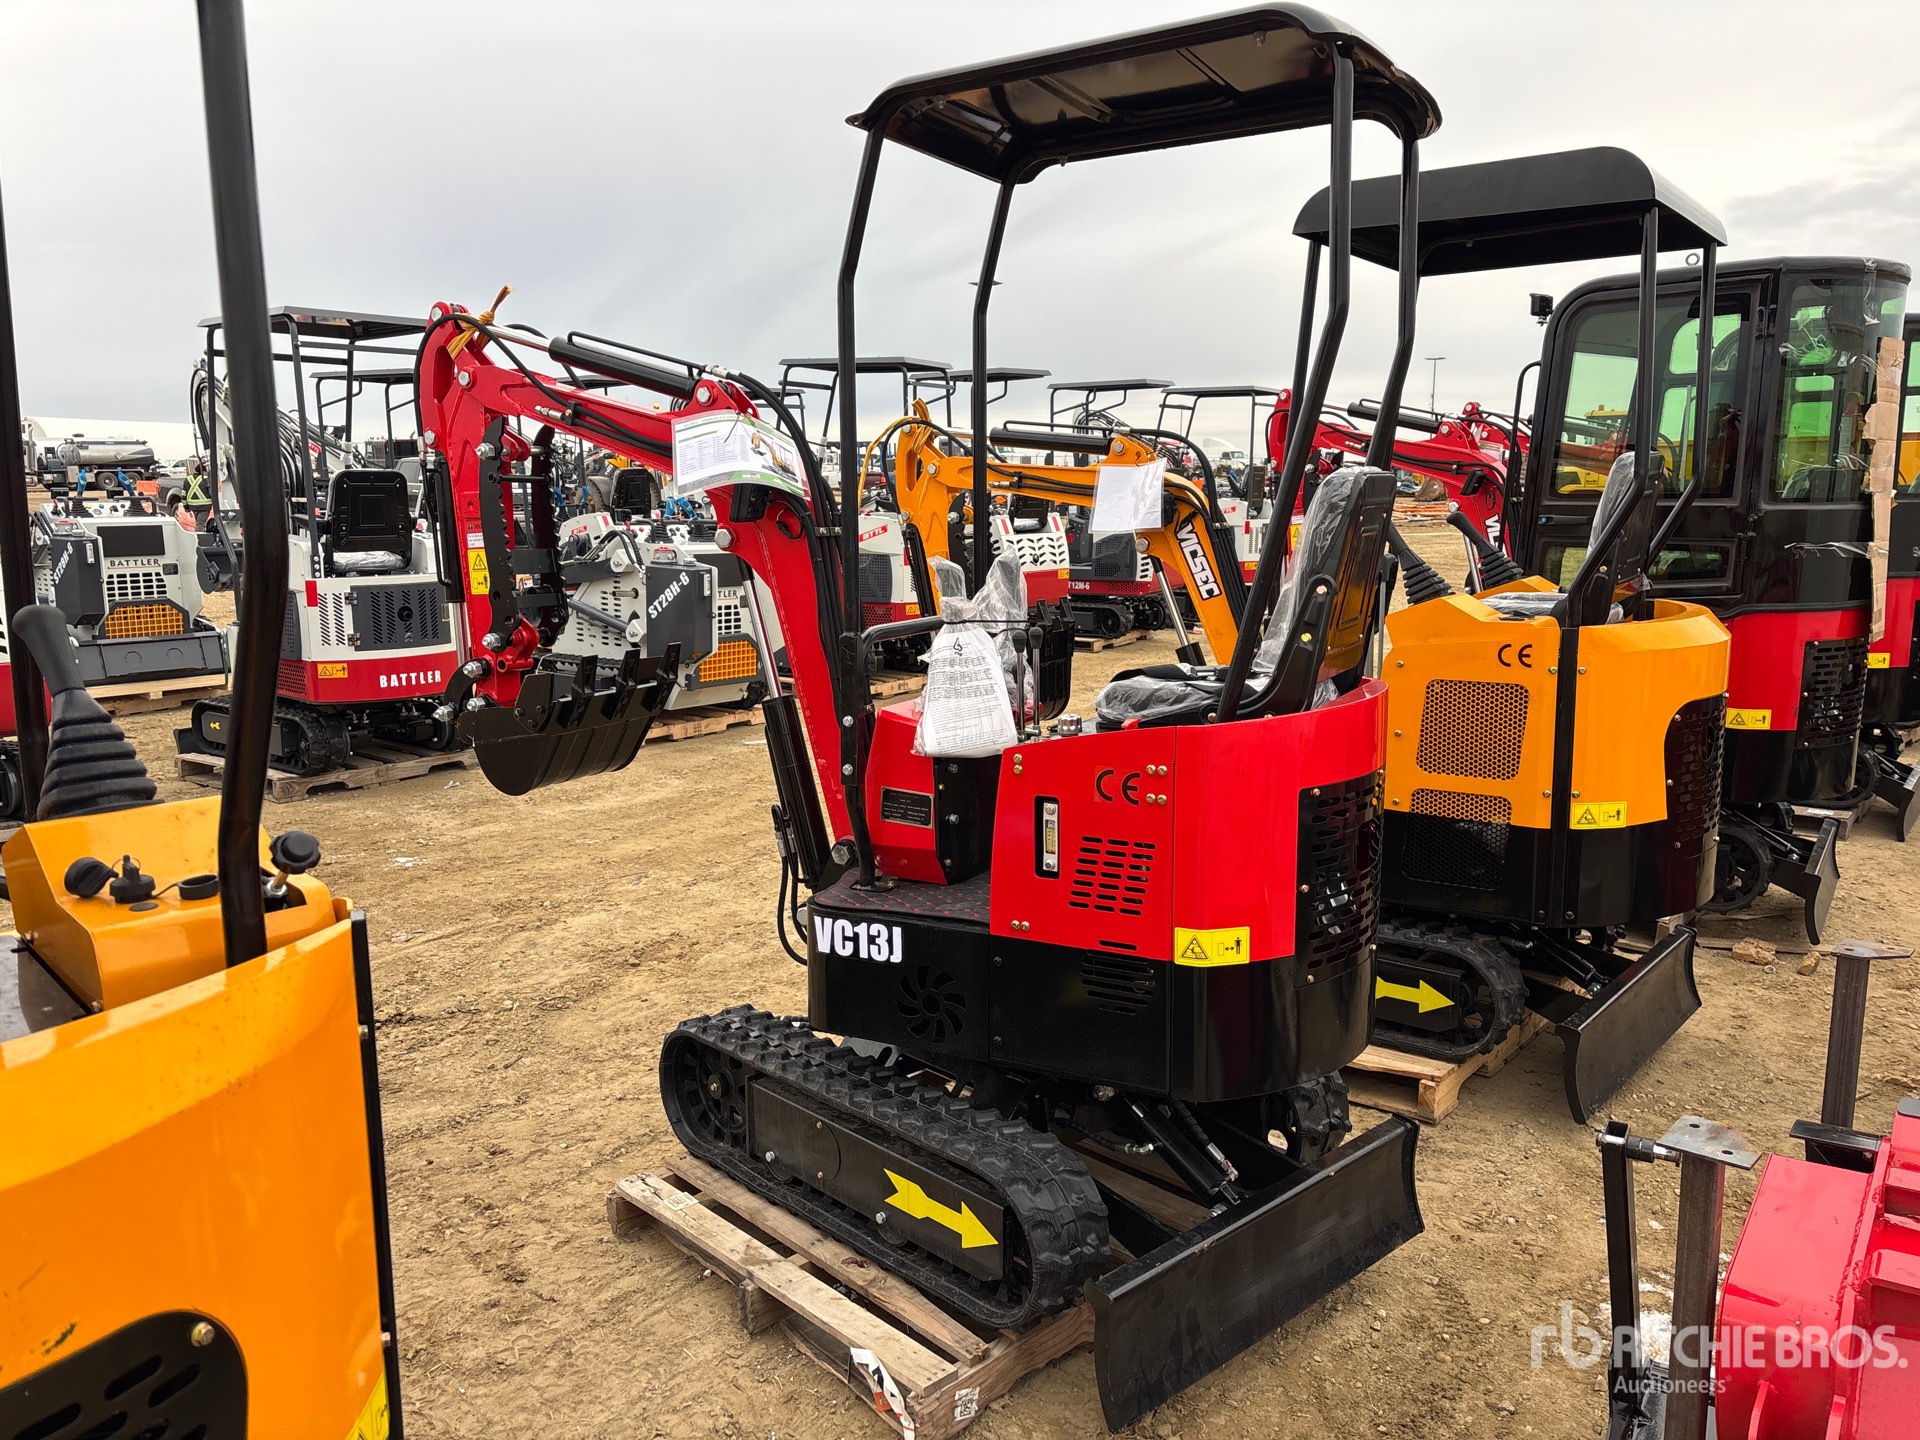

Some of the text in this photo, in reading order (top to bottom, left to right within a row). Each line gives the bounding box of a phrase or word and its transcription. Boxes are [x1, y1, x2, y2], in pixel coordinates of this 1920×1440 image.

[109, 559, 161, 568] BATTLER
[717, 590, 739, 599] TLER
[1068, 581, 1090, 590] T12M-6
[1498, 643, 1532, 668] CE
[379, 669, 442, 688] BATTLER
[1096, 769, 1141, 806] CE
[813, 915, 903, 963] VC13J
